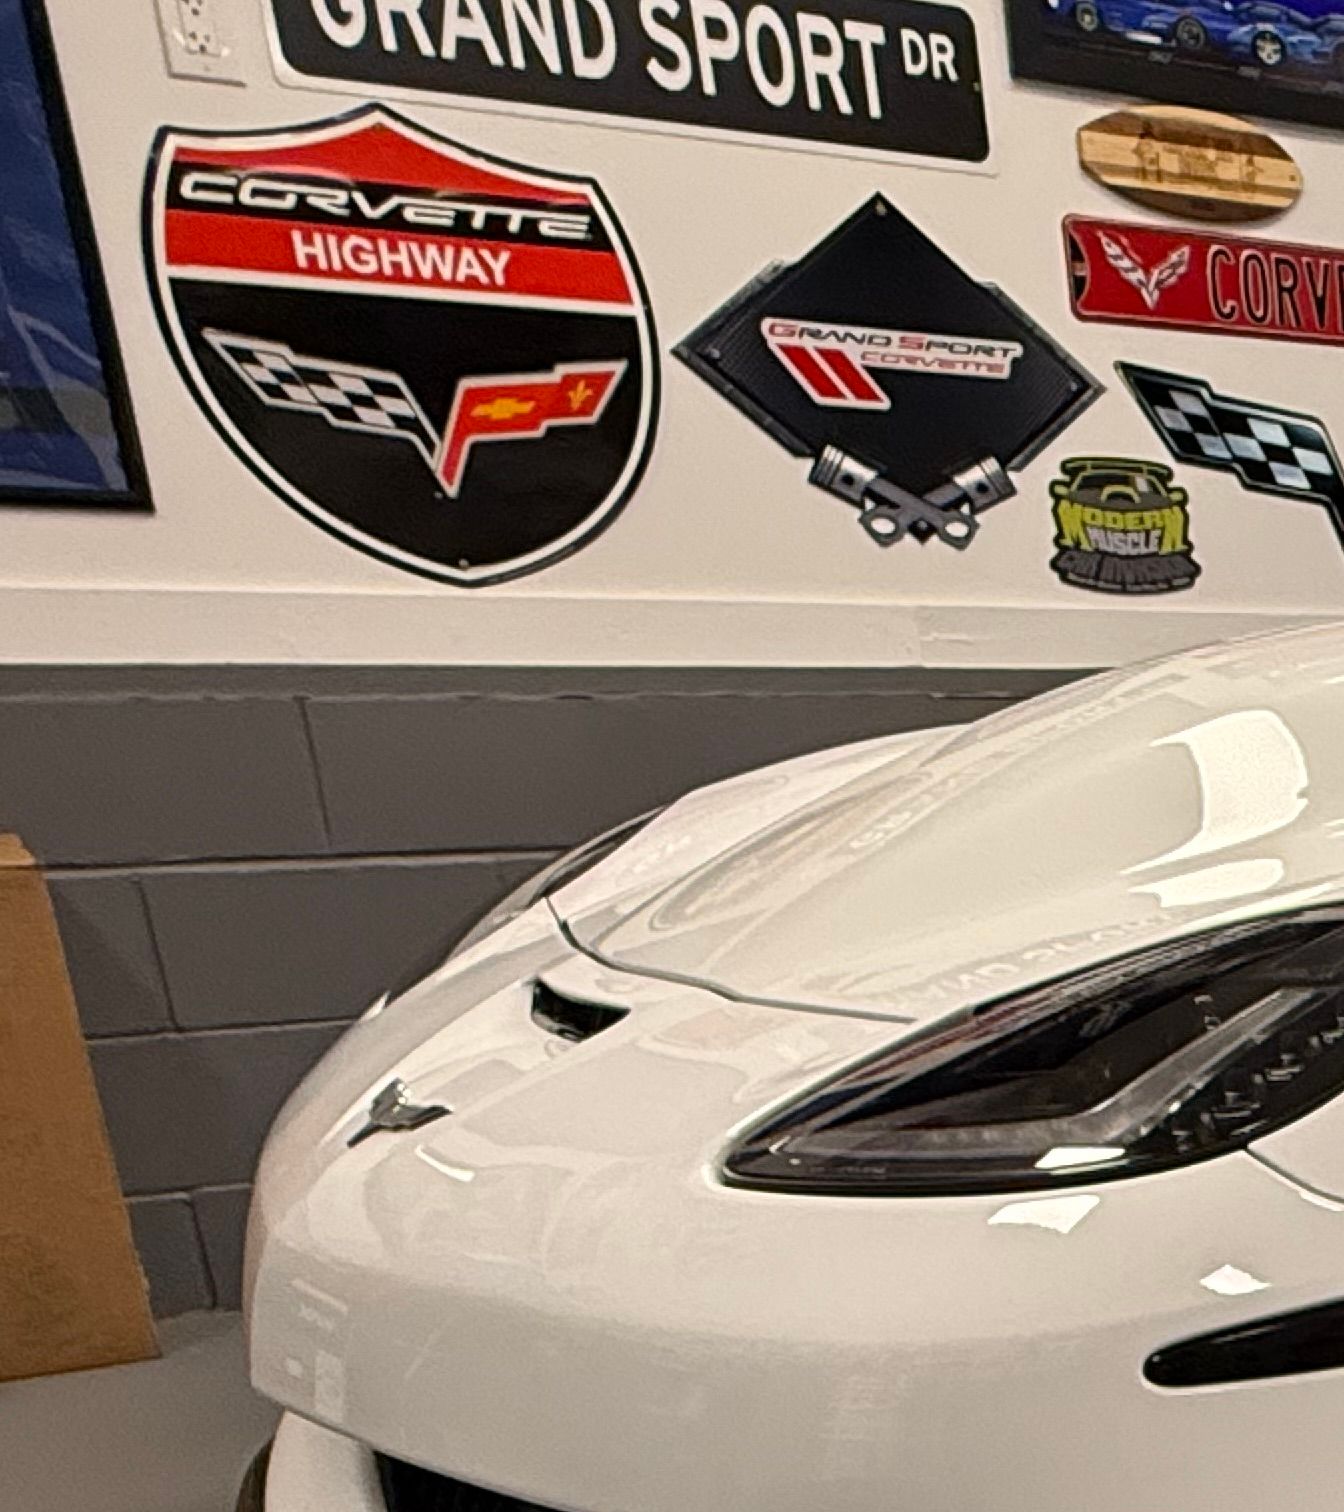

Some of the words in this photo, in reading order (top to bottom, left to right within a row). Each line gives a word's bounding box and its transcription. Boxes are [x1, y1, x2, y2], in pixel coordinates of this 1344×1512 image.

[639, 0, 886, 119] SPORT
[901, 28, 959, 82] DR
[179, 170, 592, 240] CORVETTE
[290, 229, 511, 286] HIGHWAY
[768, 321, 892, 346] GRAND
[899, 333, 1018, 358] SPORT
[860, 350, 1006, 374] CORVETTE
[1058, 499, 1190, 555] MODERN
[1087, 527, 1162, 555] MUSCLE
